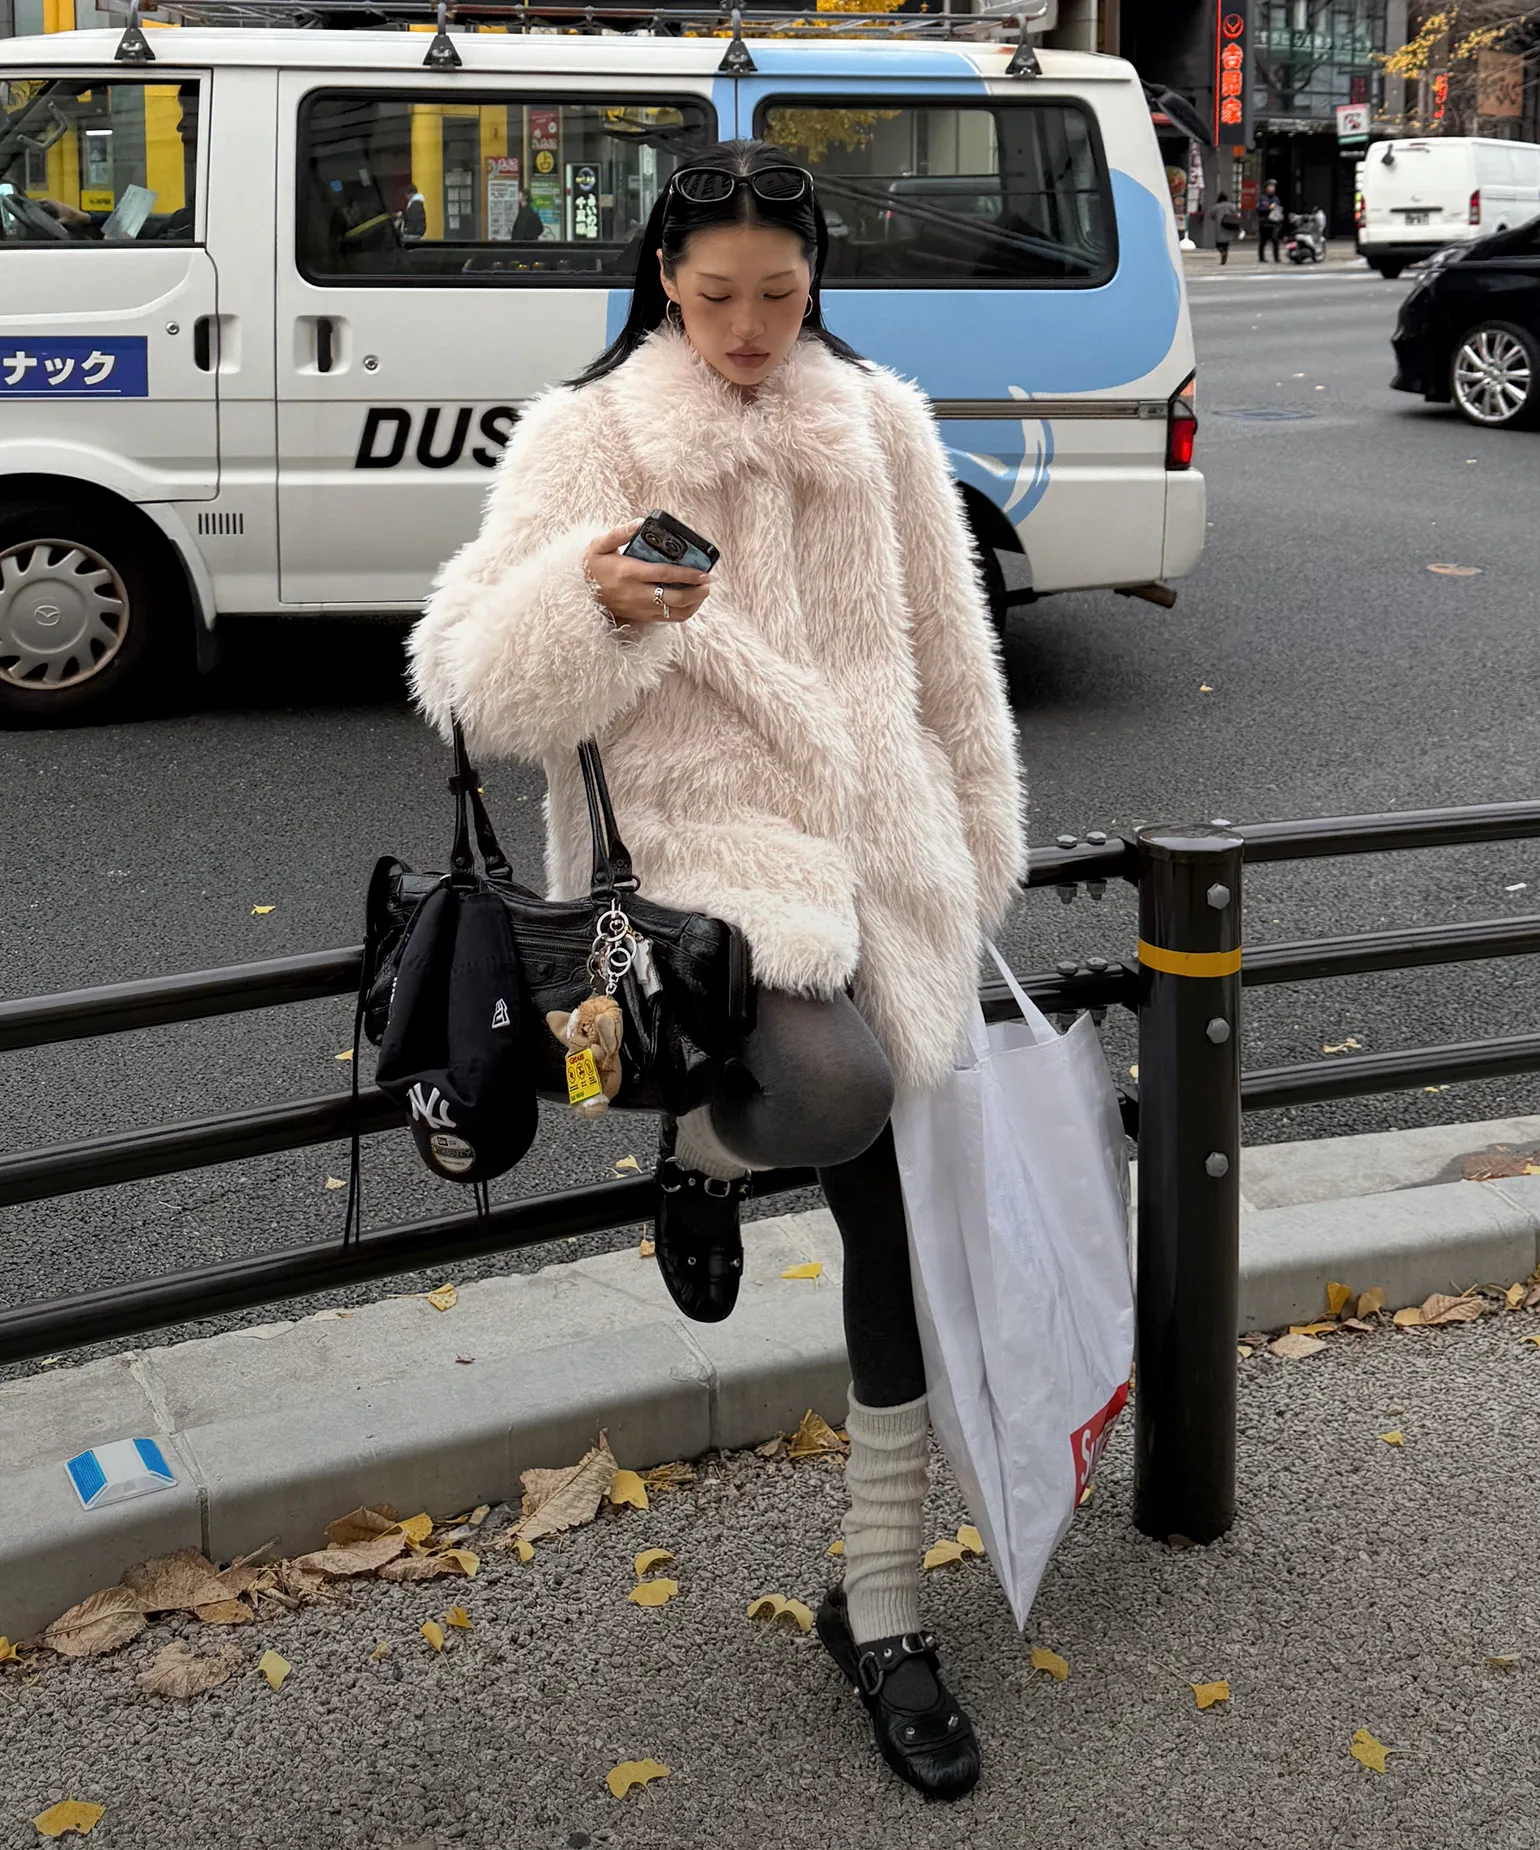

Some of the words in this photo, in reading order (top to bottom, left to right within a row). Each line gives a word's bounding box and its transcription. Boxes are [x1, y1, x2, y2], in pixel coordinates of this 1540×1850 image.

[2, 351, 115, 385] ナック
[406, 1082, 457, 1129] NY
